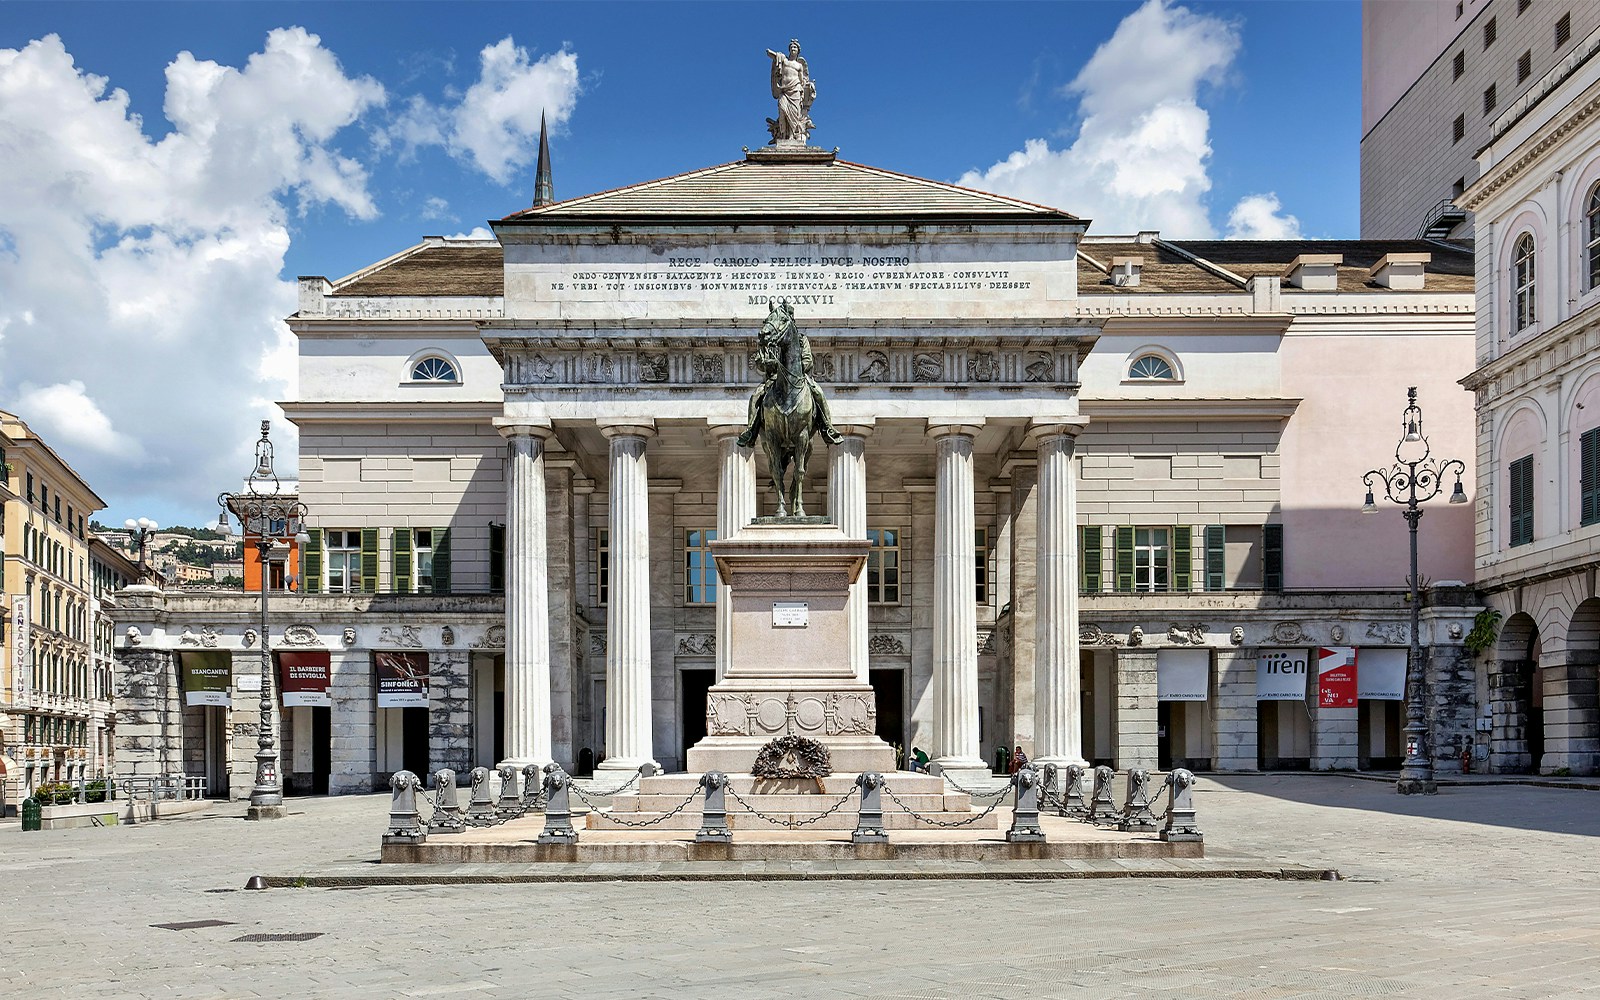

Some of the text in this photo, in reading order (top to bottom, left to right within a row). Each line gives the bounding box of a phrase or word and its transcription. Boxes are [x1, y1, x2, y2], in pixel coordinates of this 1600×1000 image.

[669, 257, 910, 267] REGE CAROLO FELICI DVCE NOSTRO
[572, 271, 1009, 280] ORDO GENVENSIS SATAGENTE HECTORE IENNEO REGIO GVBERNATORE CONSVLVIT
[776, 282, 838, 290] INSTRVCTAE
[845, 282, 902, 290] THEATRVM
[909, 282, 982, 290] SPECTABILIVS
[989, 282, 1031, 290] DEESSET
[1267, 658, 1305, 674] iren
